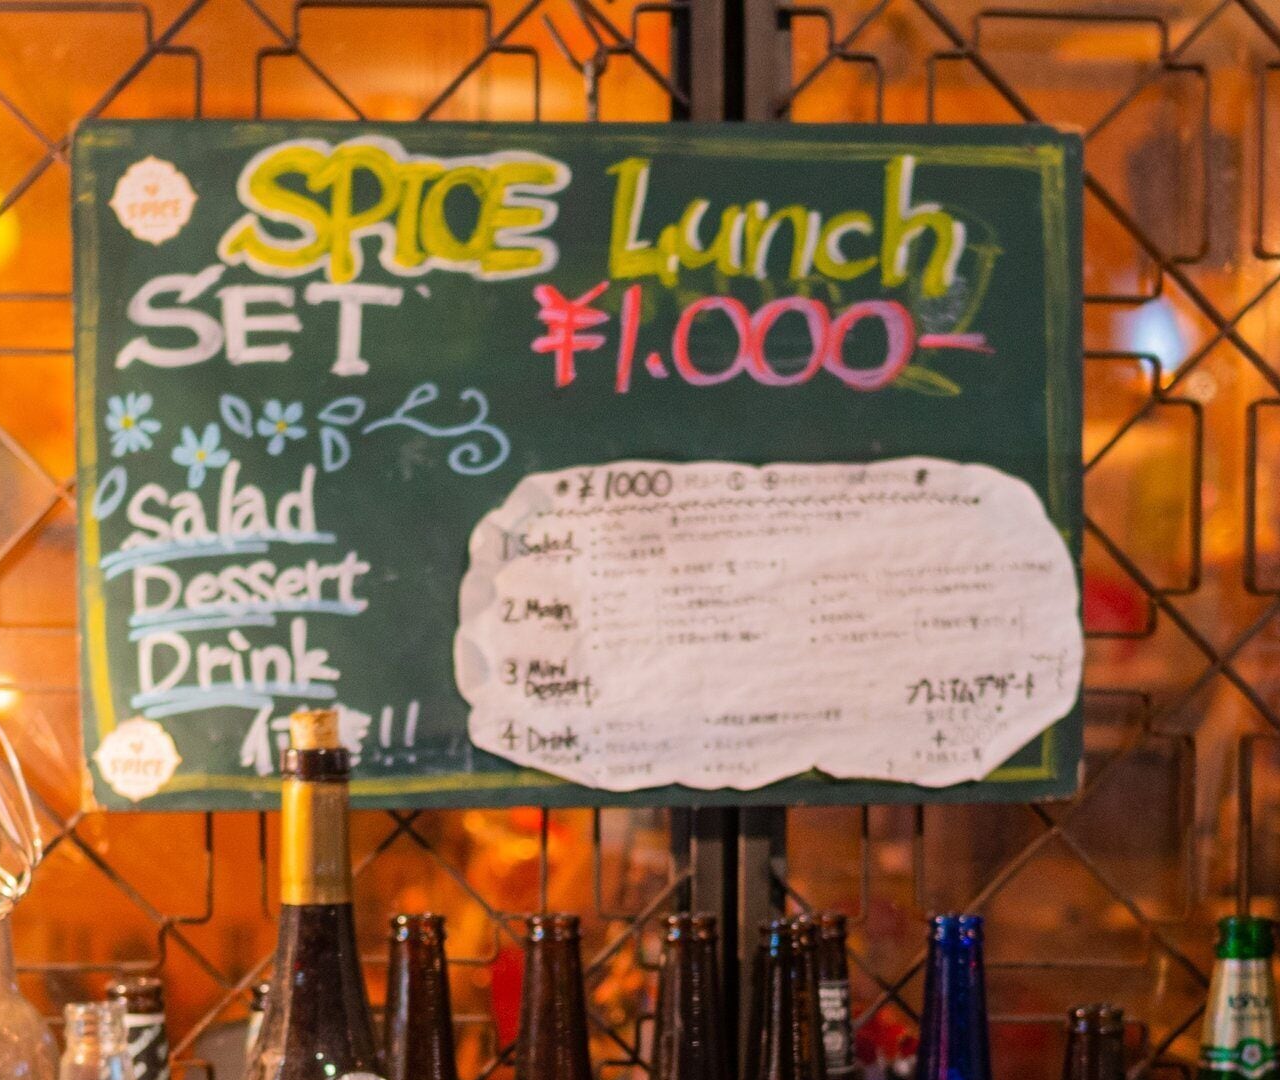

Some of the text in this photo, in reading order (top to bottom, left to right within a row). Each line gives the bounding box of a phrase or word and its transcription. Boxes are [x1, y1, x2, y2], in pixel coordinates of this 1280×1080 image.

[218, 136, 968, 297] SPICE Lunch
[115, 266, 406, 377] SET
[121, 460, 317, 550] Salad
[133, 551, 371, 615] Dessert
[138, 617, 341, 693] Drink
